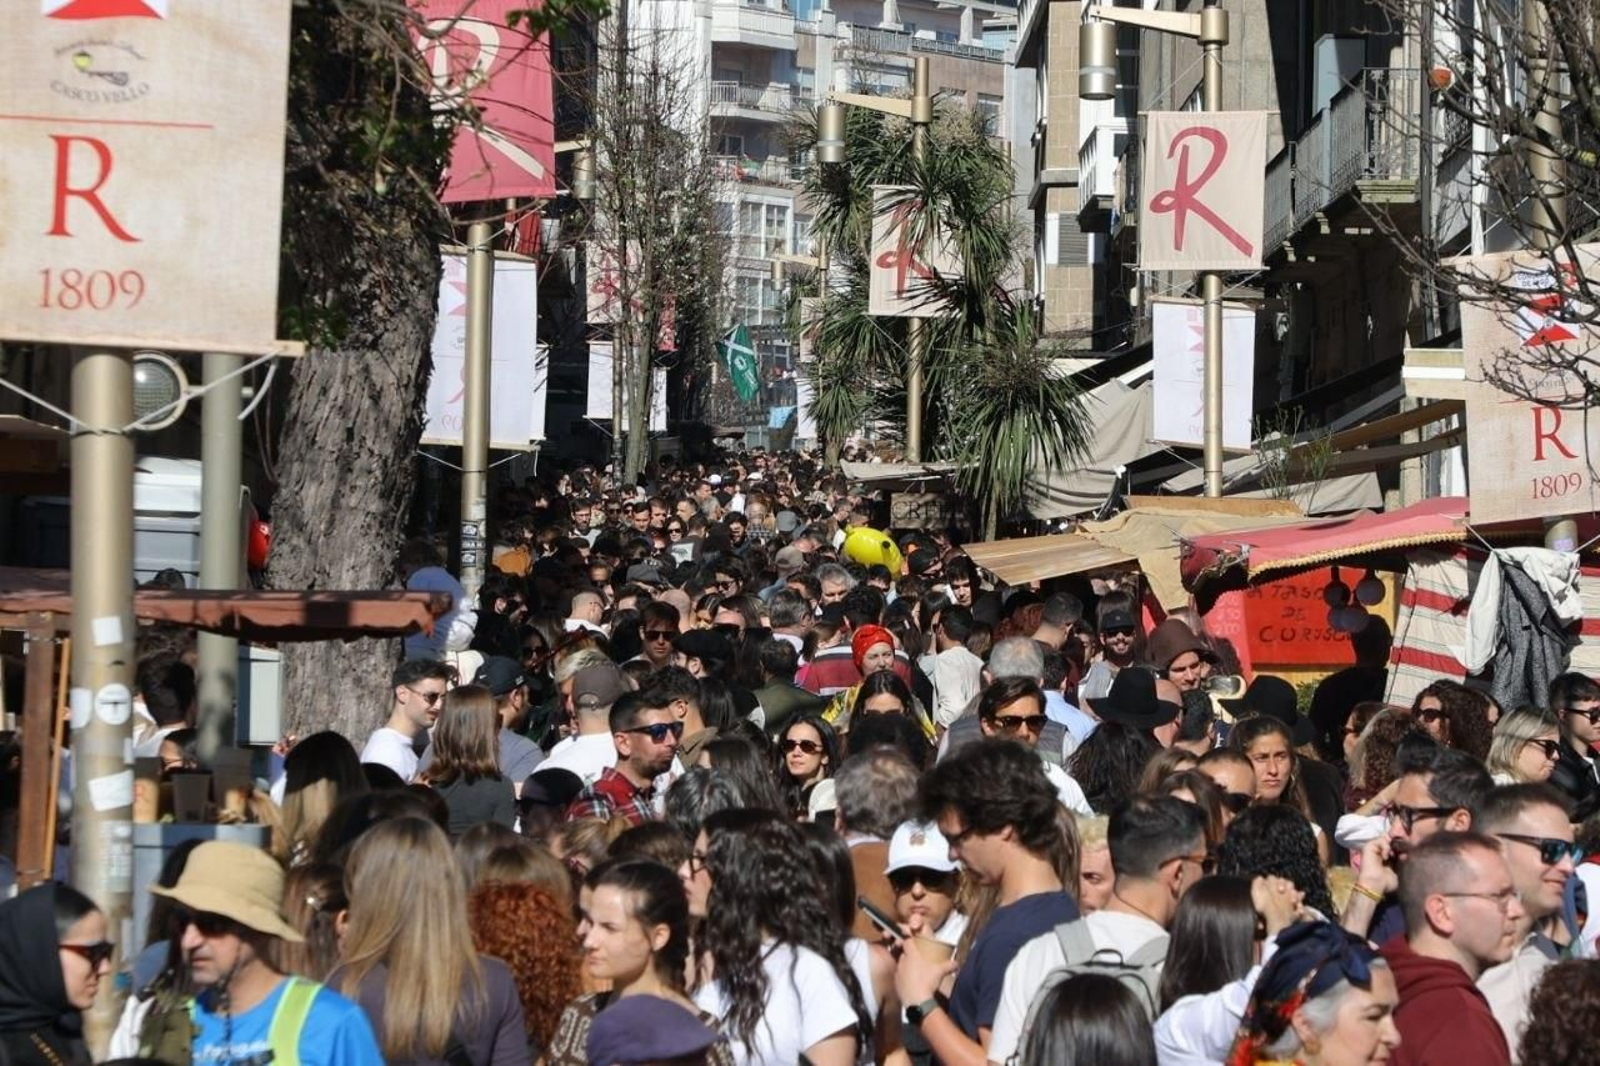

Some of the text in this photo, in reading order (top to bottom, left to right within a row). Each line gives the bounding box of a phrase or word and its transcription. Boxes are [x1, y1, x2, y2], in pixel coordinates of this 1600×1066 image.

[45, 134, 143, 243] R
[1149, 126, 1254, 258] R
[40, 267, 145, 311] 1809
[1530, 405, 1580, 461] R
[1530, 472, 1582, 499] 1809
